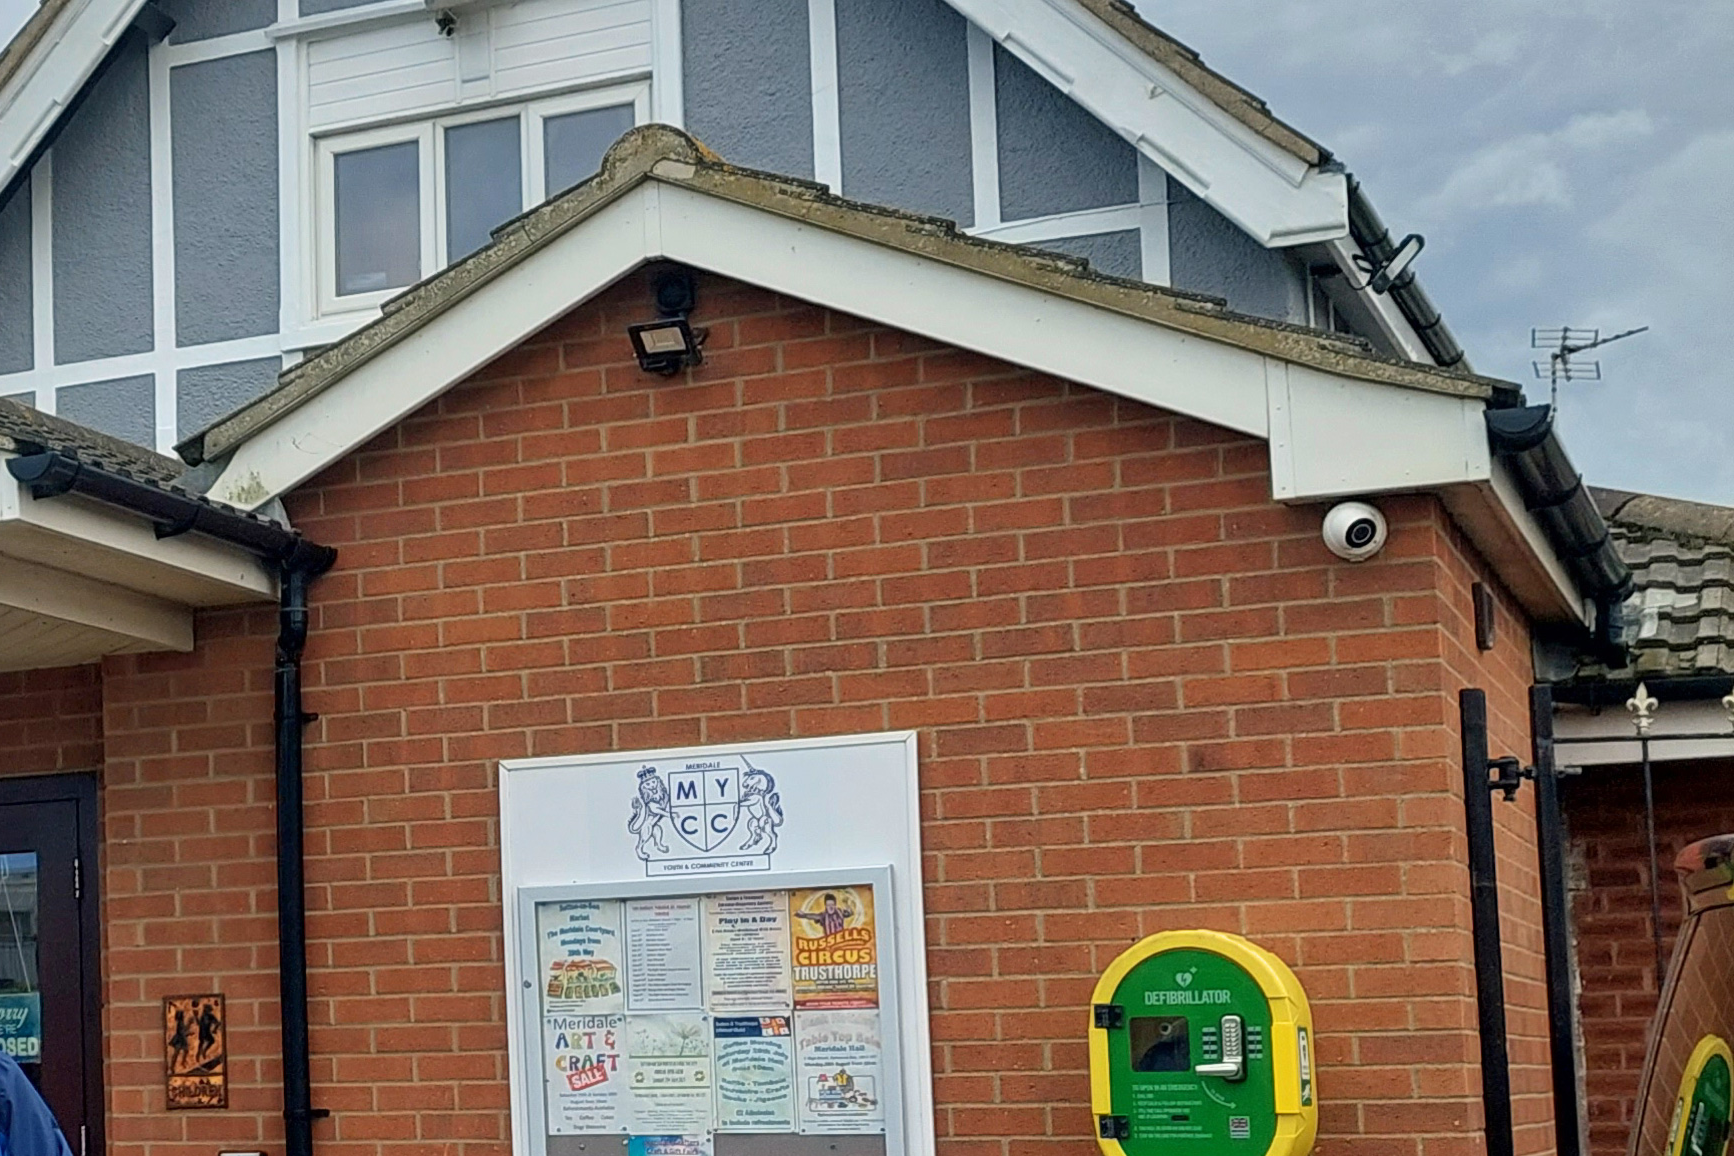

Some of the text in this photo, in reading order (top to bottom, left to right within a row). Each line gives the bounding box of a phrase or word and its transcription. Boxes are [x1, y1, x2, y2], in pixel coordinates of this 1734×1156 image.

[686, 762, 720, 770] MERIDALE
[677, 778, 729, 800] M Y
[681, 814, 729, 835] C C
[797, 928, 871, 951] RUSSELLS
[798, 948, 871, 965] CIRCUS
[793, 964, 877, 981] TRUSTHORPE
[1144, 989, 1231, 1005] DEFIBRILLATOR
[553, 1016, 618, 1030] Meridale
[555, 1029, 616, 1050] ART &
[555, 1053, 620, 1073] CRAFT
[571, 1067, 604, 1089] SALE
